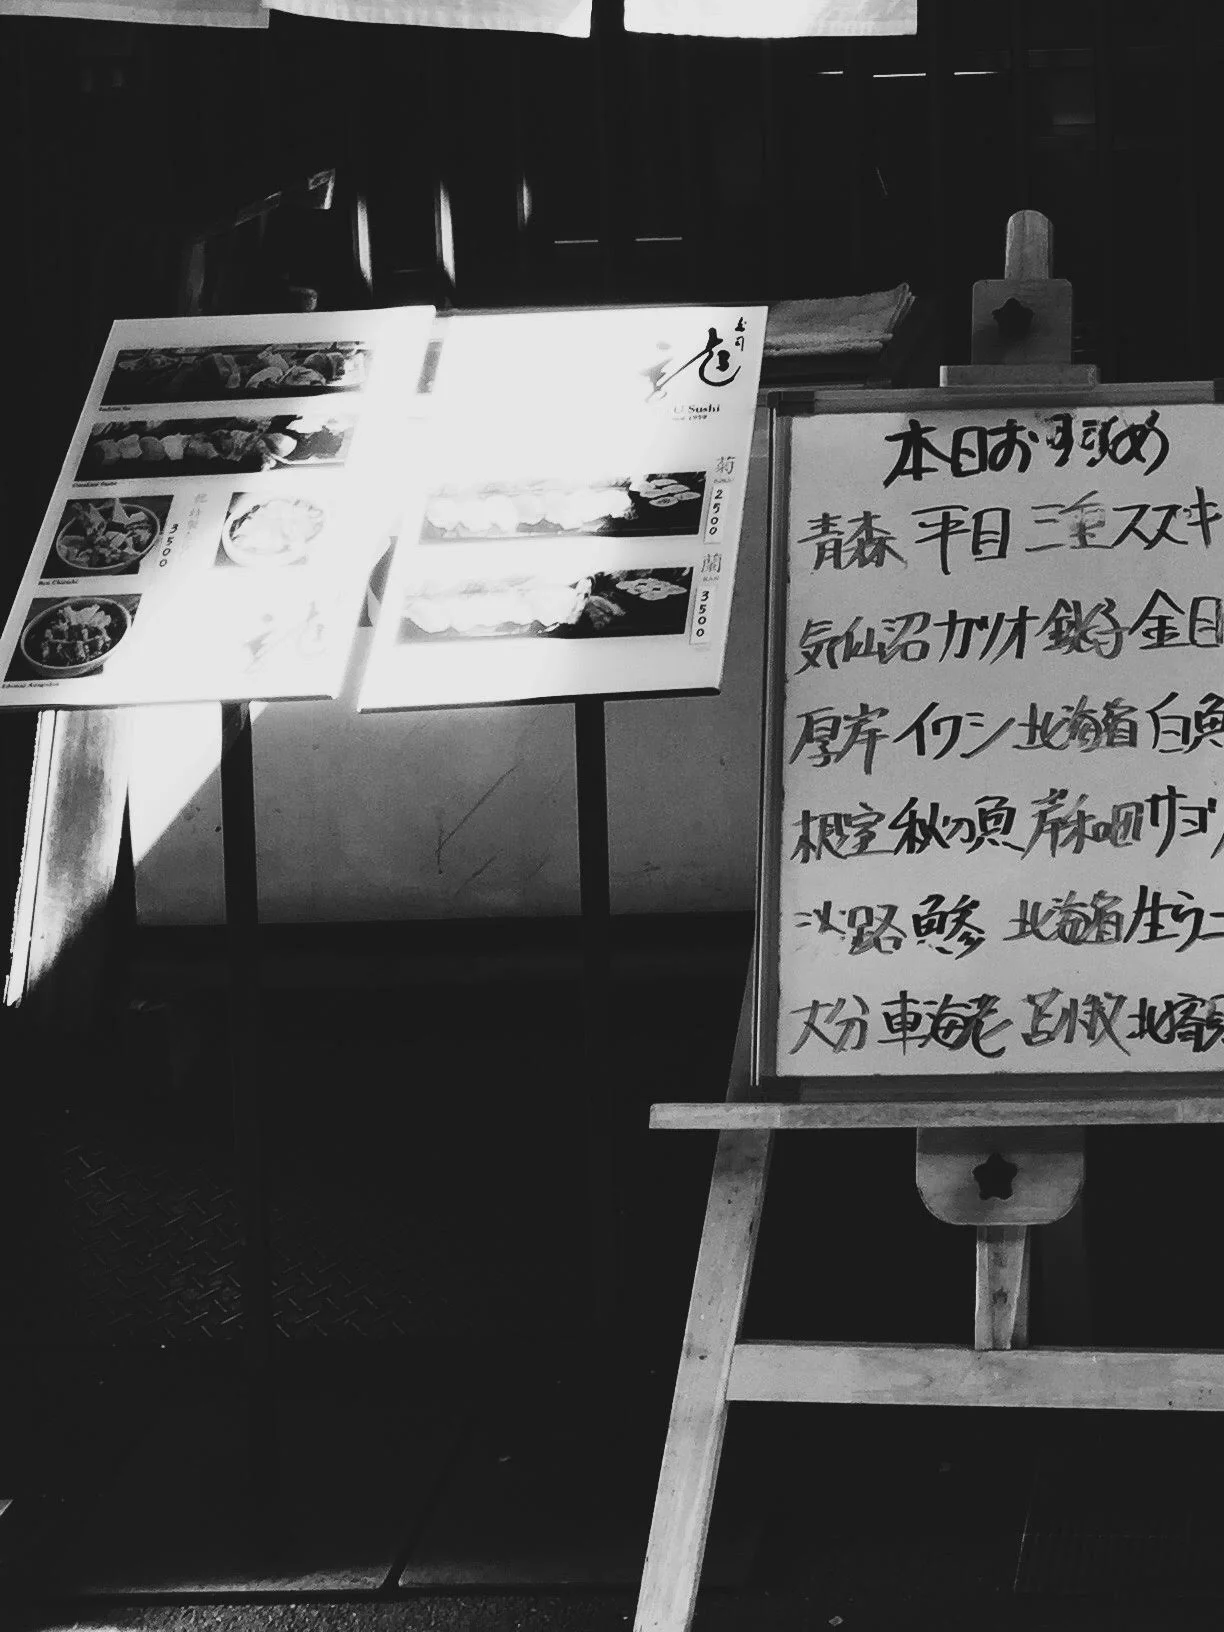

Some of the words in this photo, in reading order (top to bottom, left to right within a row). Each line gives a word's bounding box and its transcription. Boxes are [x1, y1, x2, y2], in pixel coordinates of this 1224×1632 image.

[797, 510, 908, 570] 青森
[911, 504, 1011, 575] 平目
[1128, 588, 1224, 650] 金目
[893, 701, 1016, 760] イワシ
[788, 994, 870, 1055] 大分
